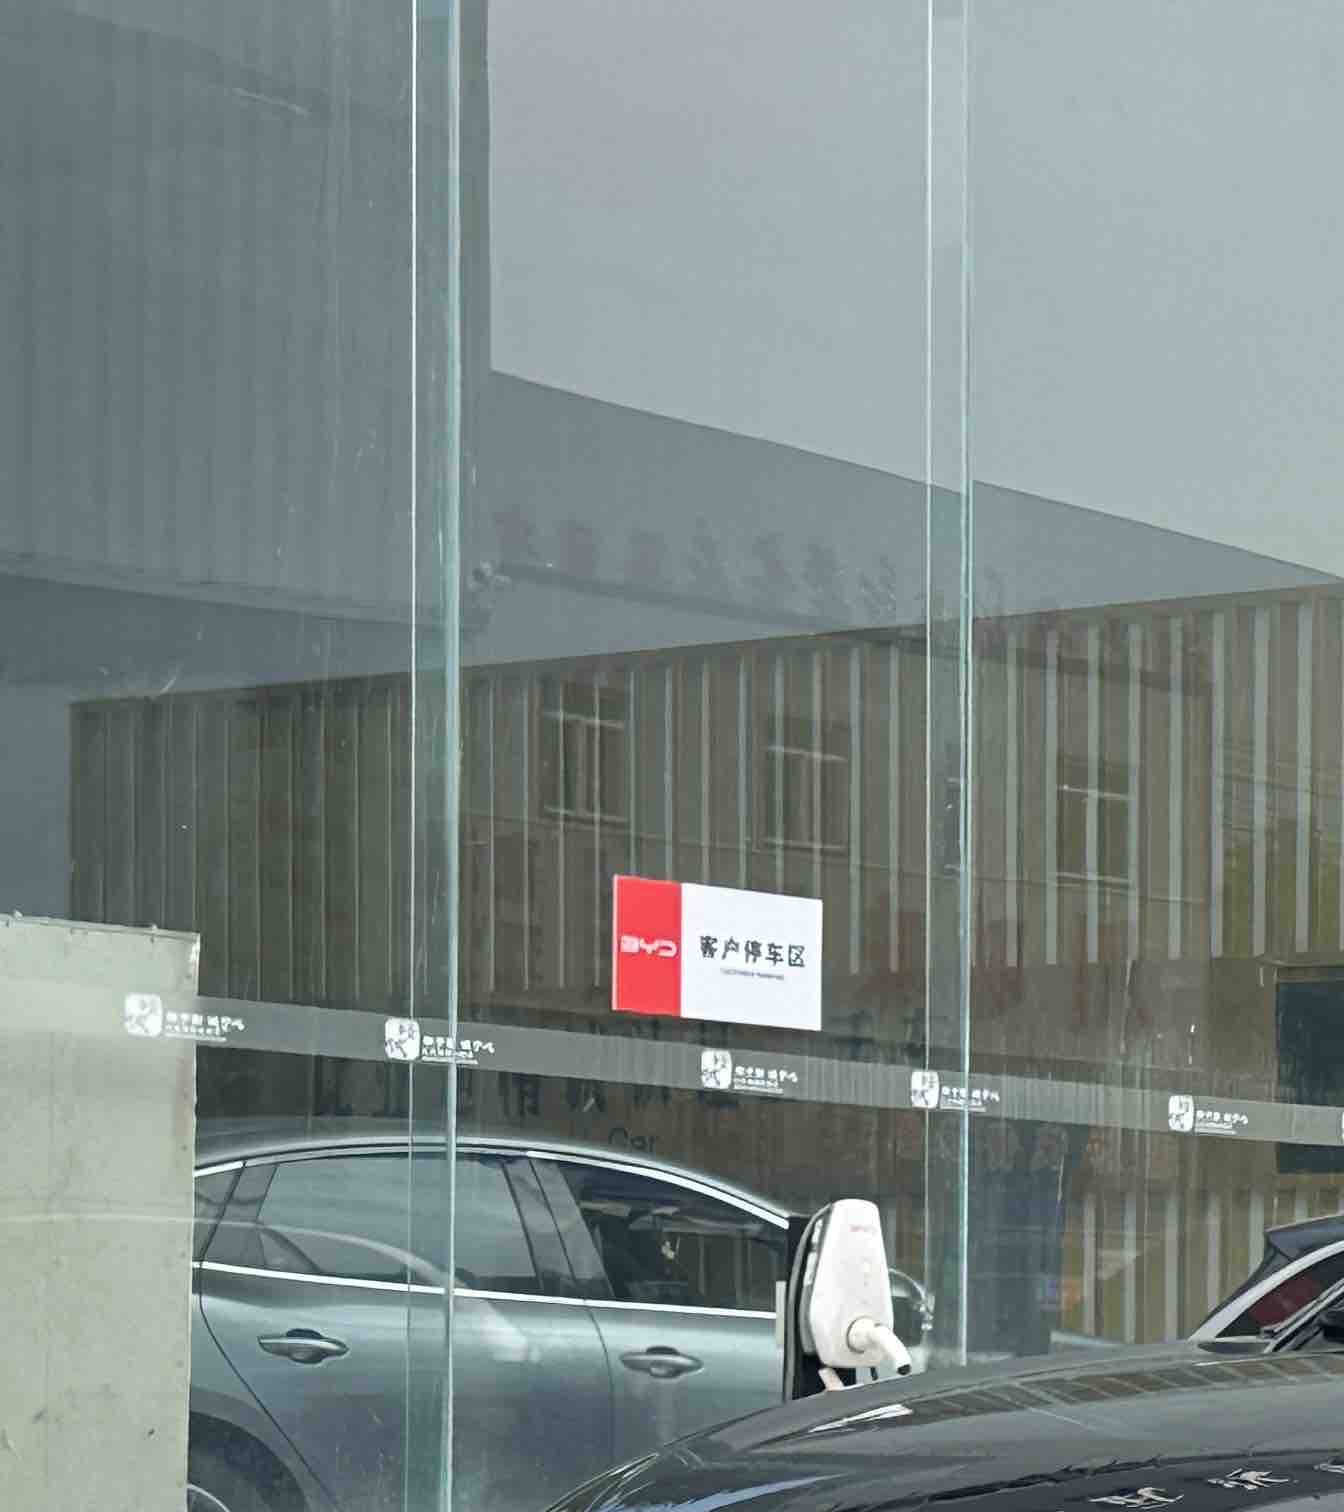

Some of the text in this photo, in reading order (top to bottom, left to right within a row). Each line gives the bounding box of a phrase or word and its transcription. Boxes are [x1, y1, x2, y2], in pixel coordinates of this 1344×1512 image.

[620, 934, 678, 958] BYD
[700, 935, 806, 968] 客户停车区
